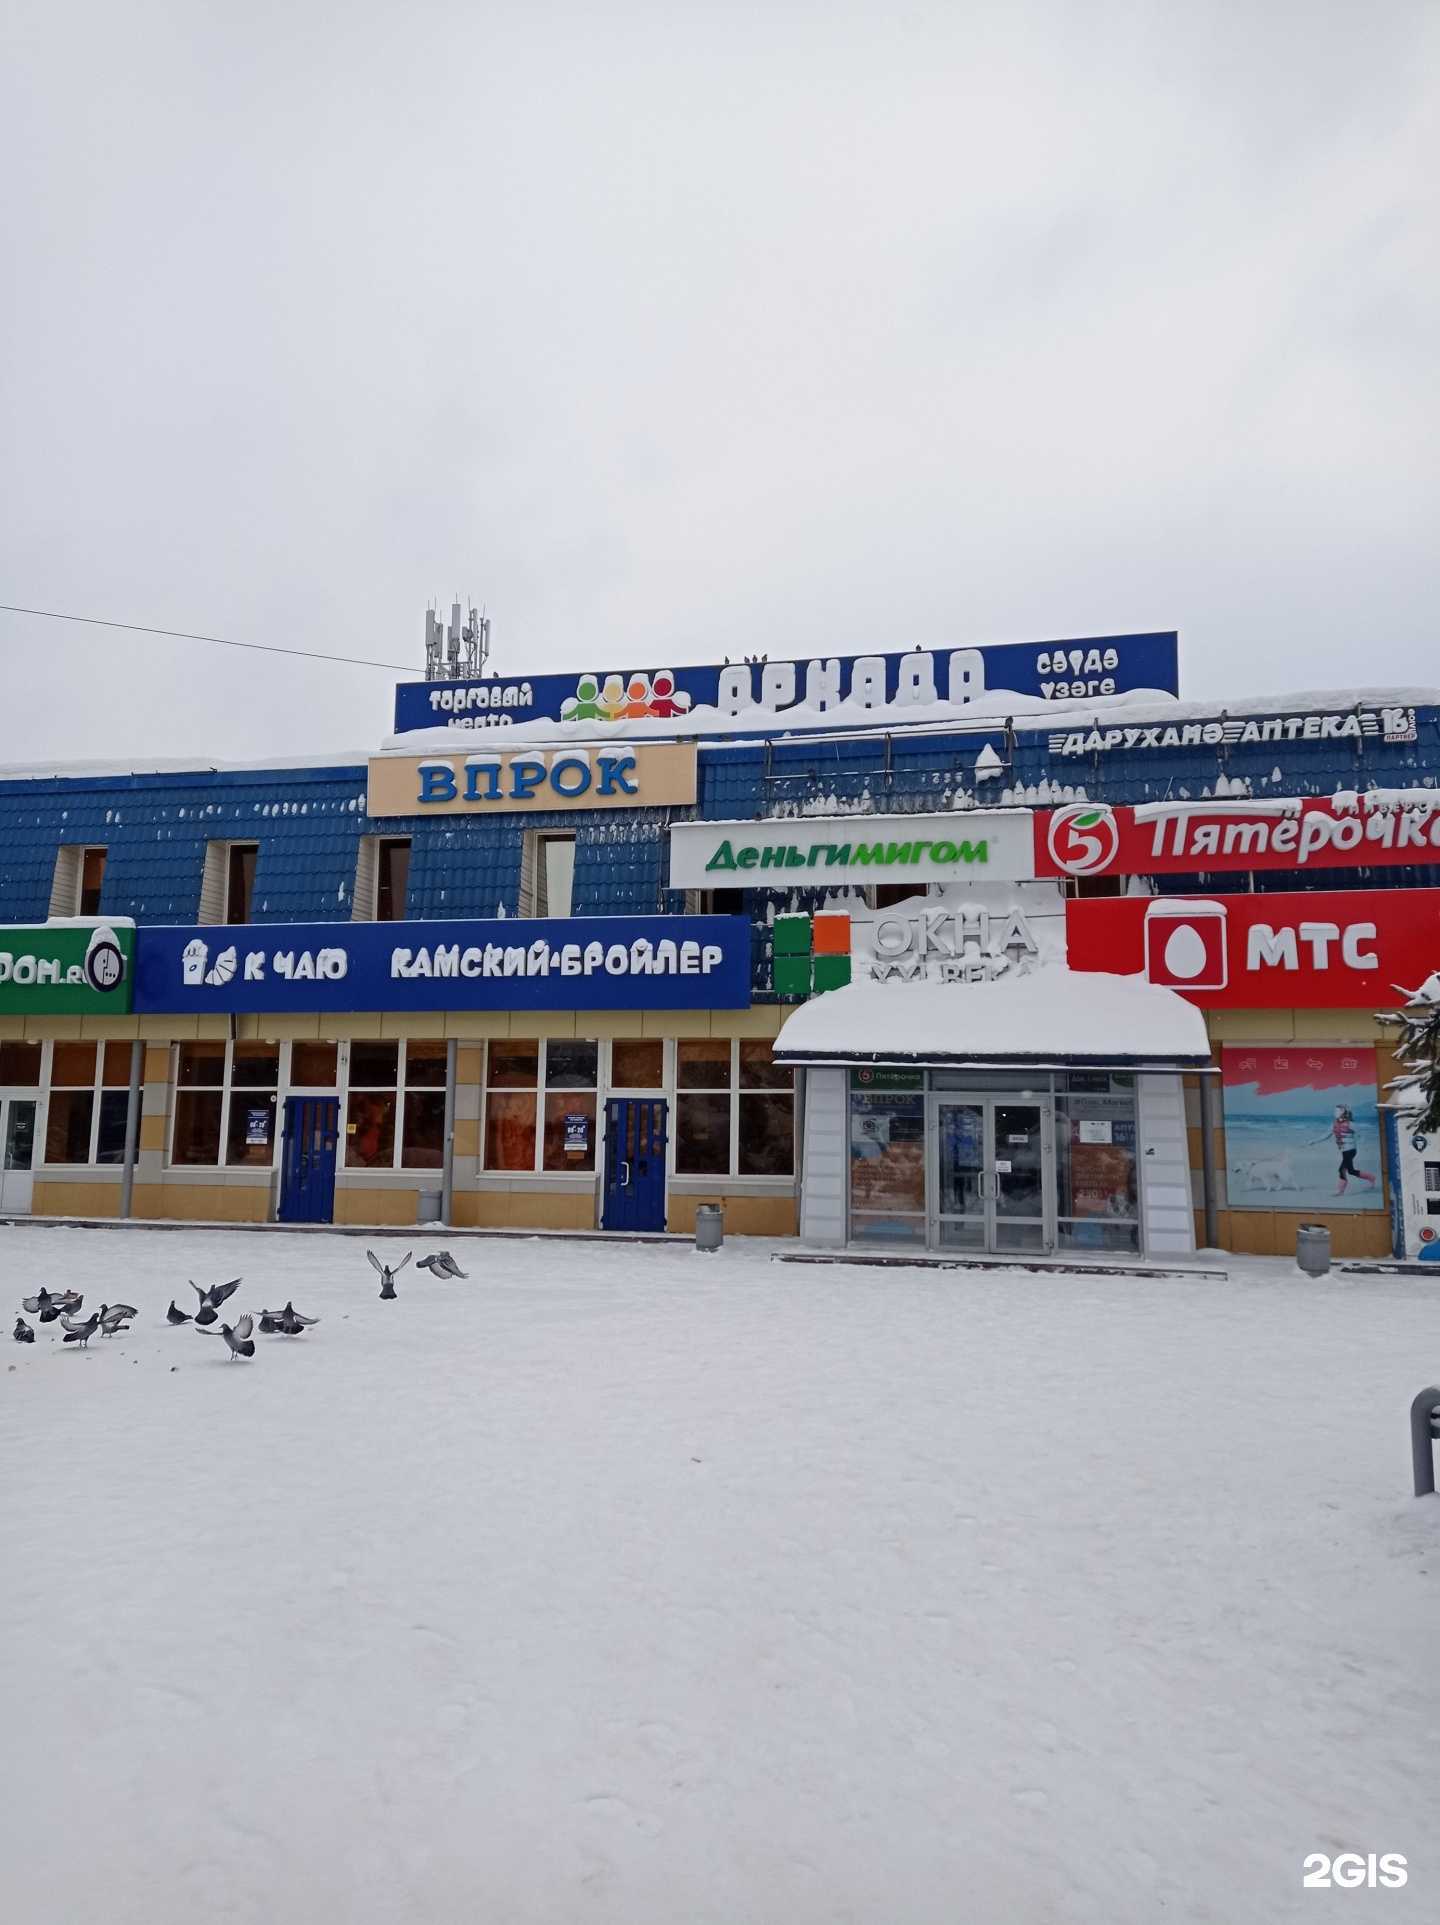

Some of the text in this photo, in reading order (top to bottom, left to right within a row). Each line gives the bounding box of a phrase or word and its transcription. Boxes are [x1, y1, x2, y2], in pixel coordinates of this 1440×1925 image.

[1239, 714, 1363, 743] АПТЕКА
[417, 754, 639, 802] ВПРОК
[1134, 801, 1440, 864] Пятёрочк
[872, 910, 1039, 957] ОКНА
[1246, 922, 1380, 971] МТС
[243, 948, 348, 981] К ЧАЮ
